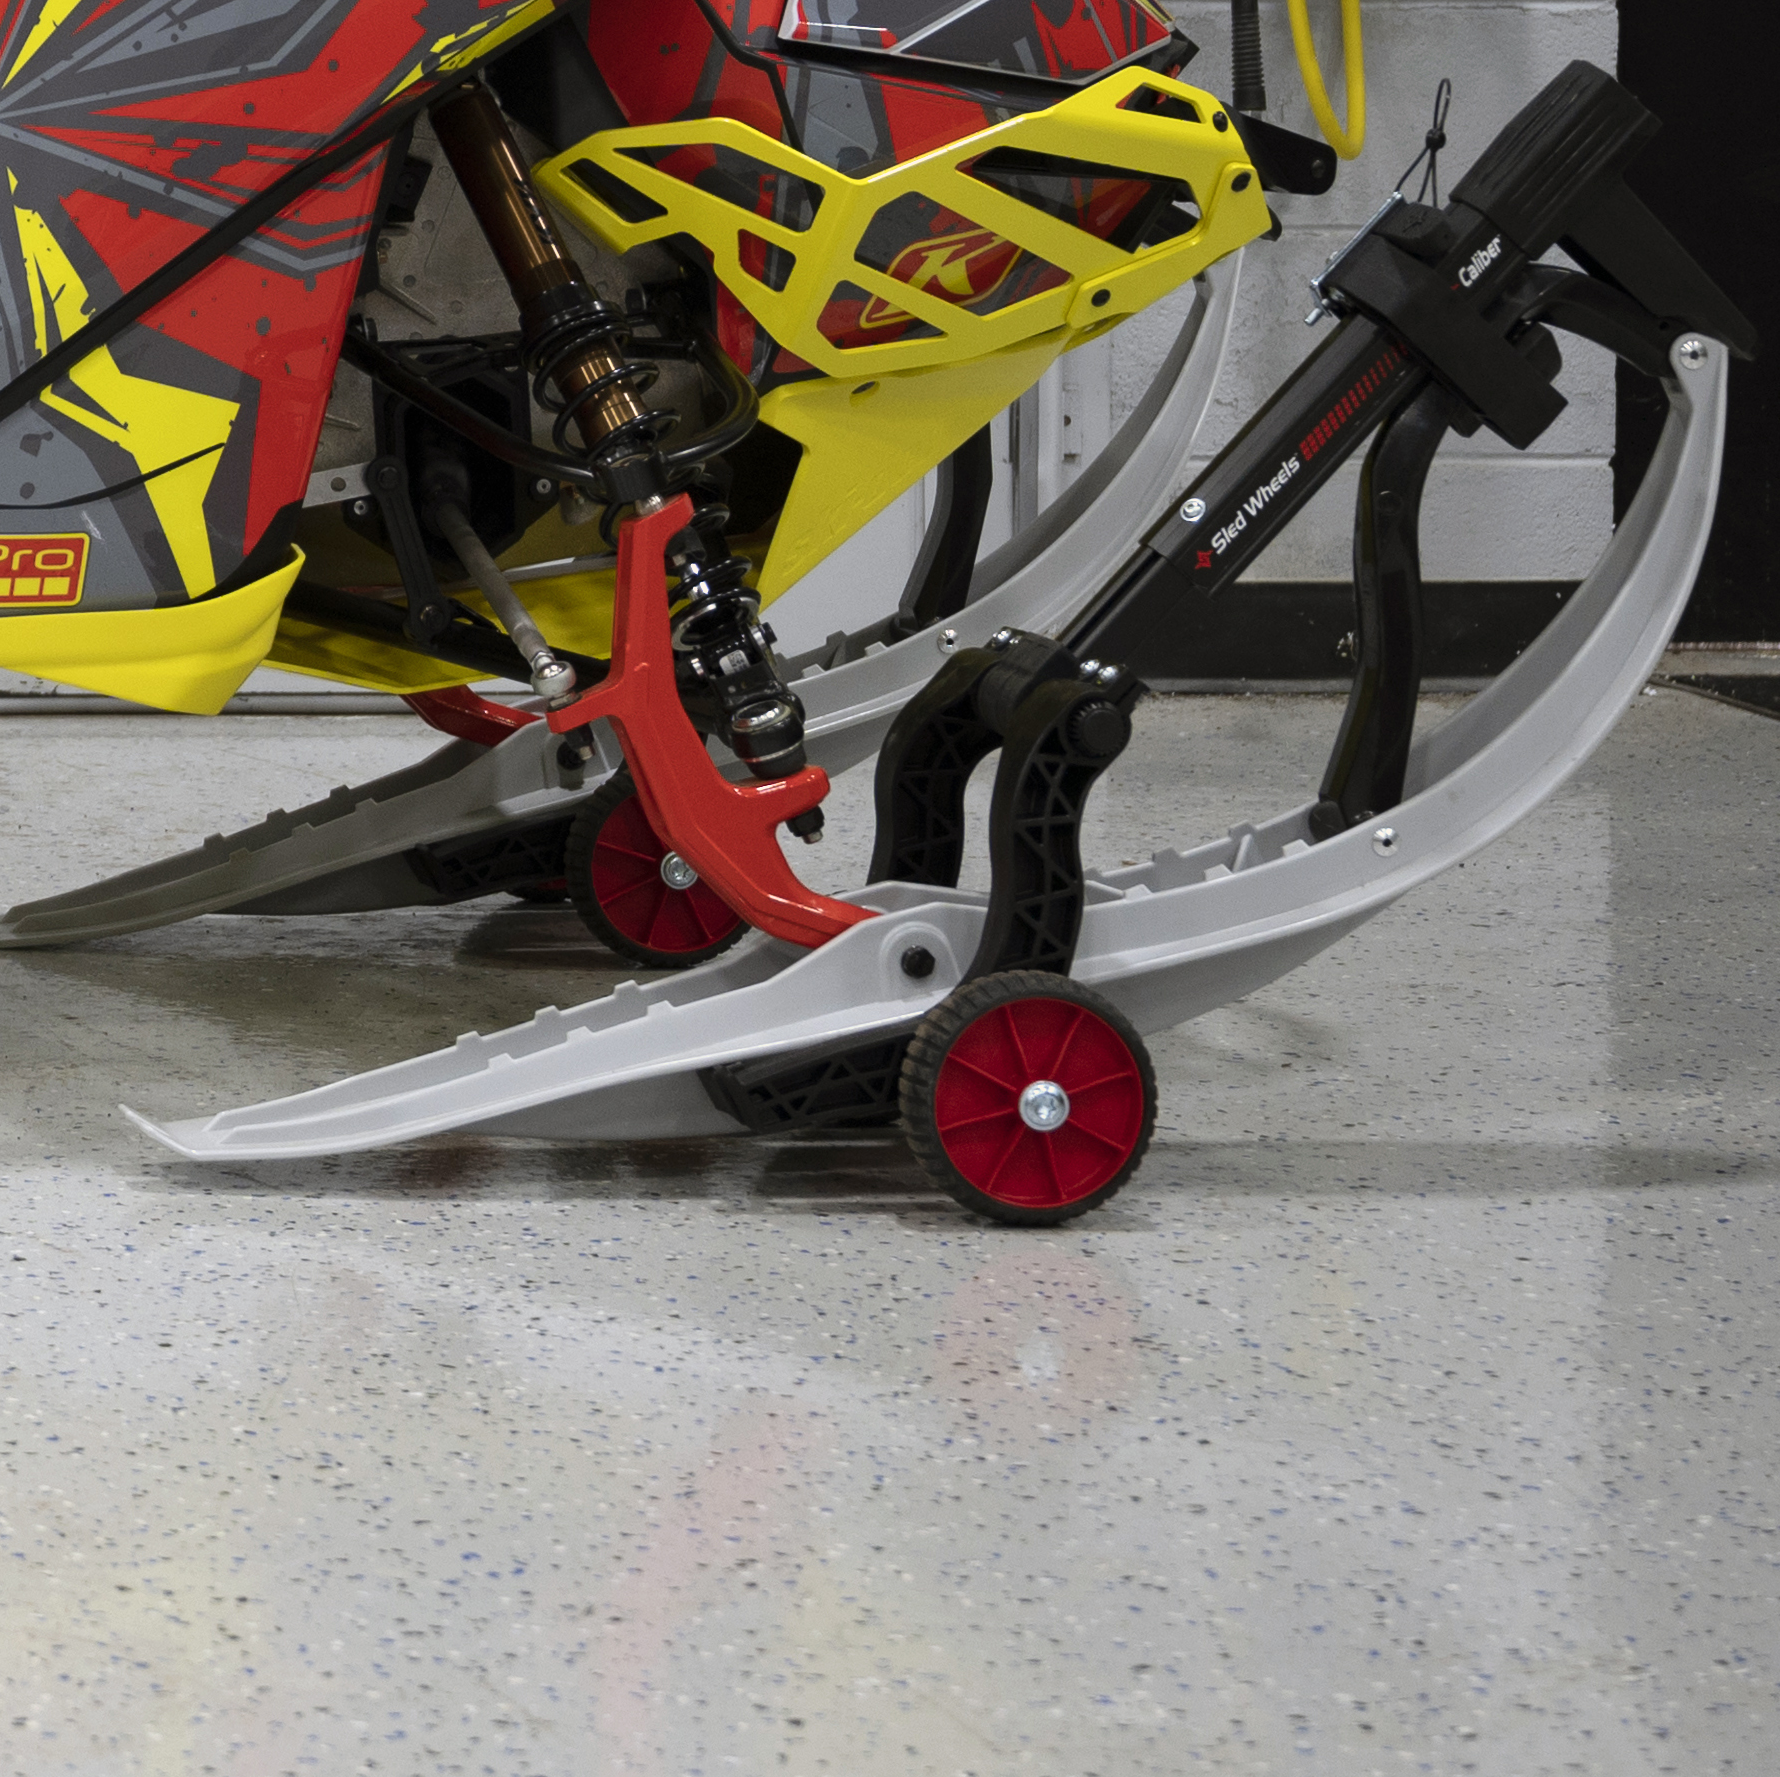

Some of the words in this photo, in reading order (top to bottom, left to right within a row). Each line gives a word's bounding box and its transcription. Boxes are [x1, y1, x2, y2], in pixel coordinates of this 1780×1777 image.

[1458, 236, 1501, 287] Caliber
[1210, 509, 1247, 555] Sled
[1242, 455, 1300, 517] Wheels
